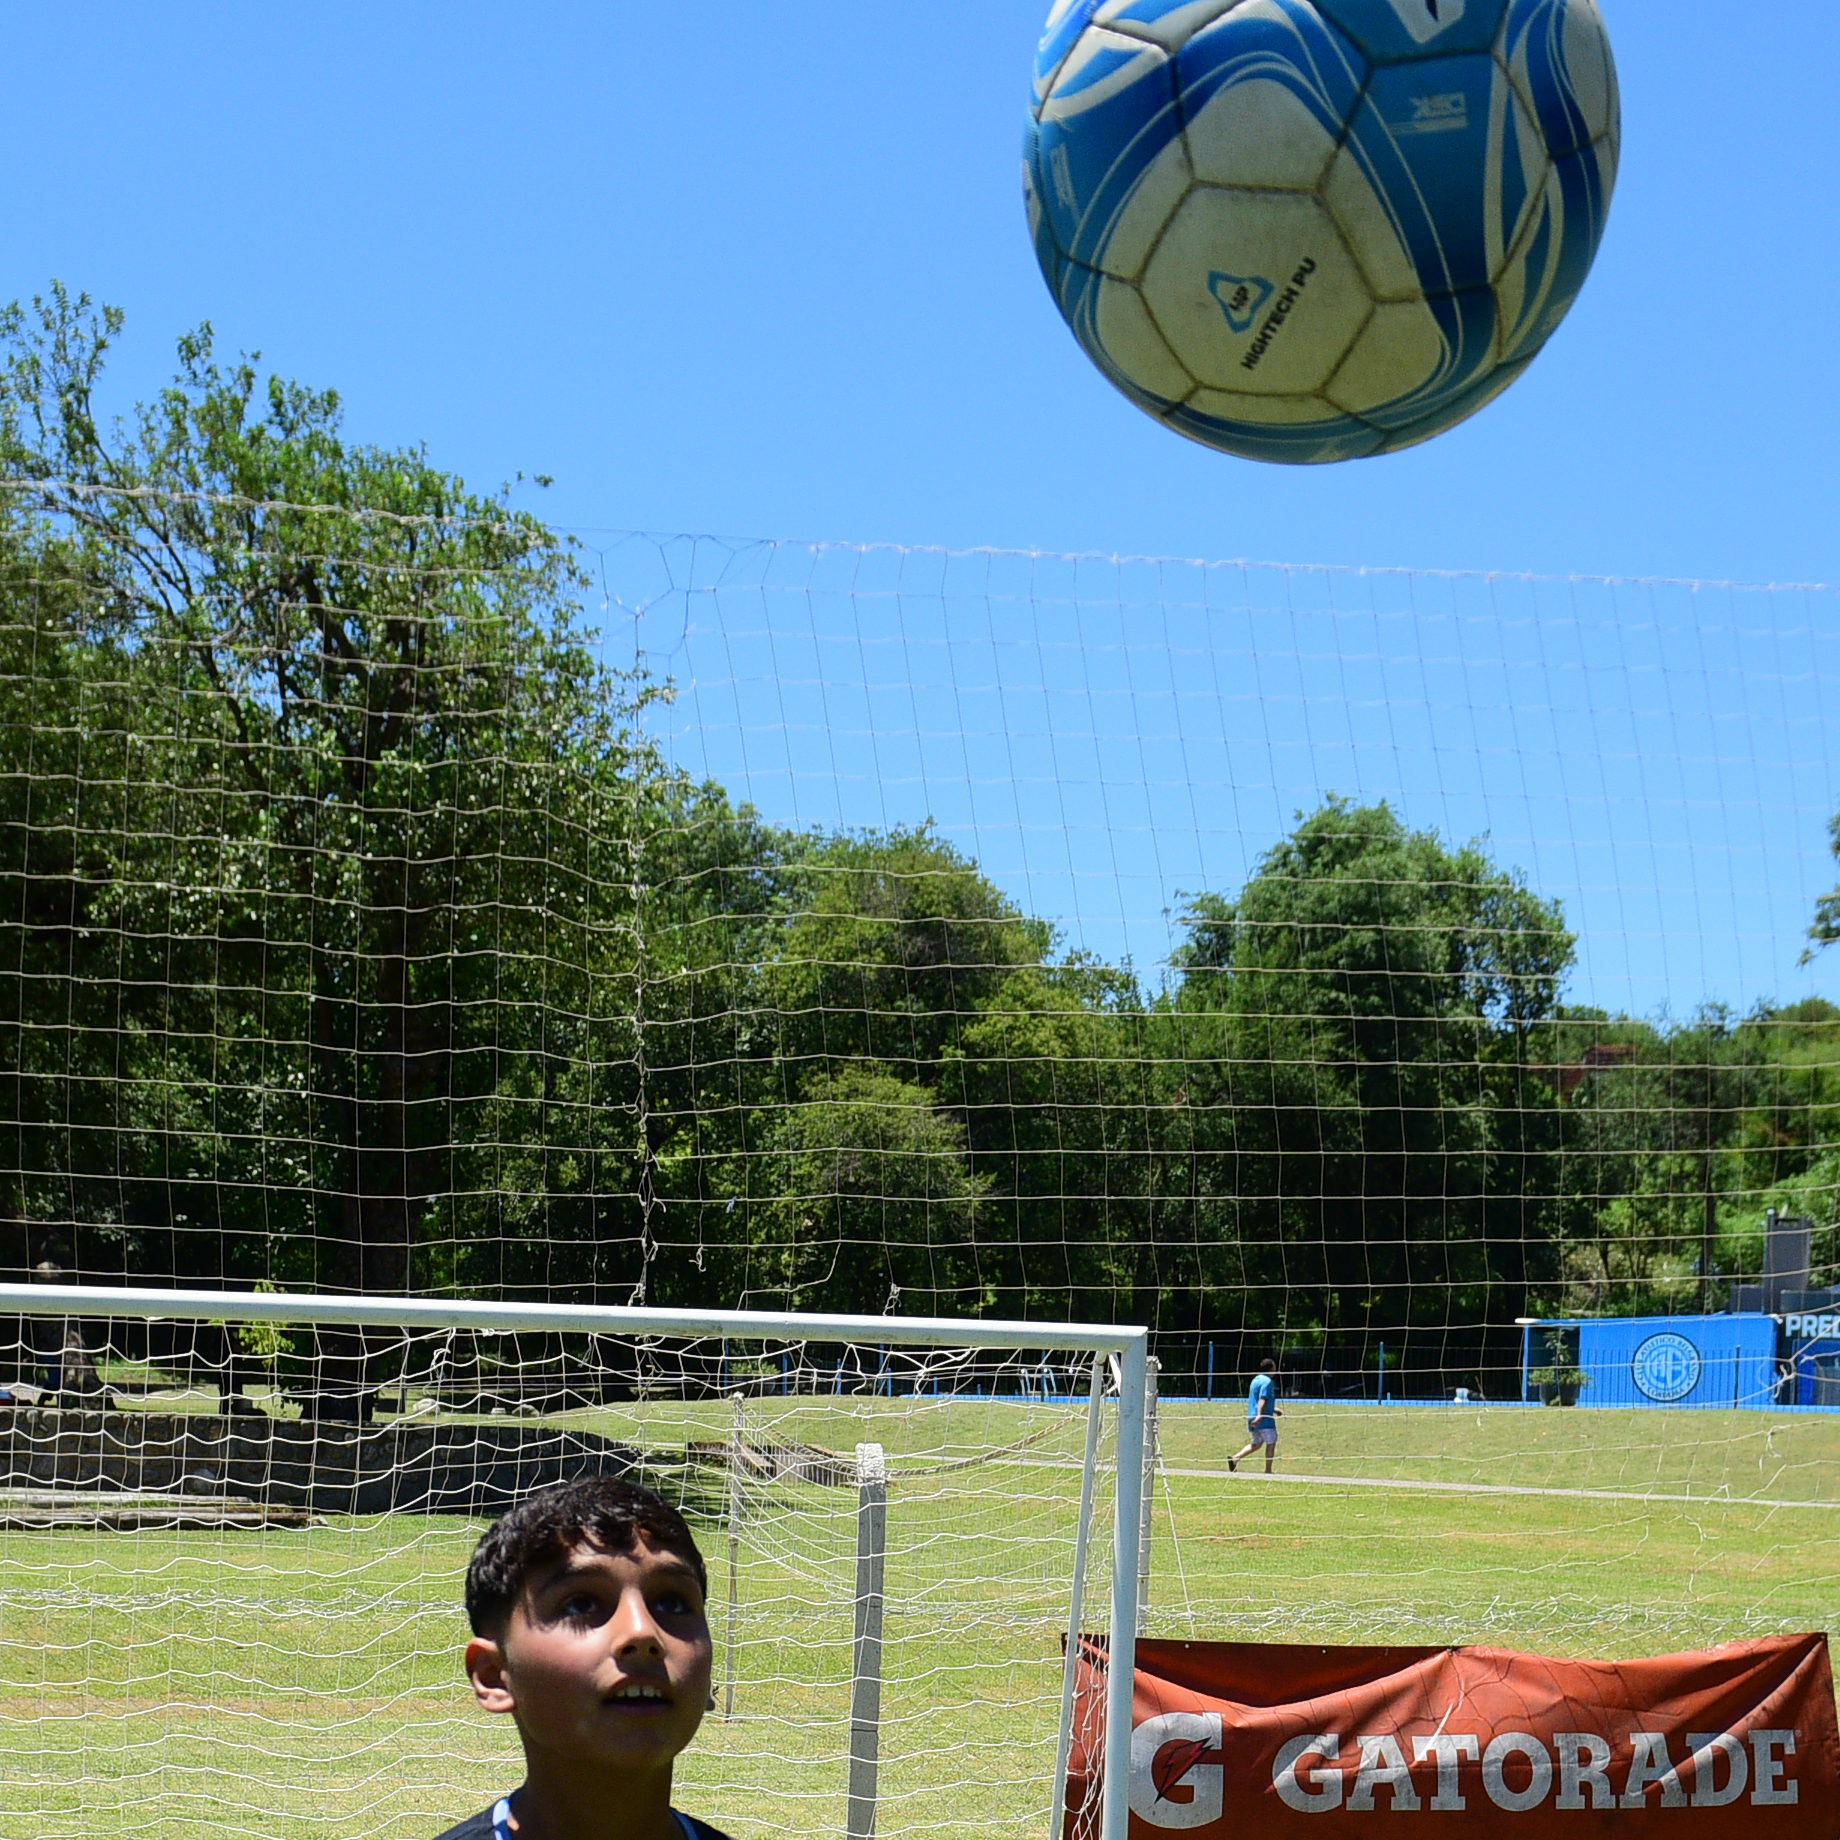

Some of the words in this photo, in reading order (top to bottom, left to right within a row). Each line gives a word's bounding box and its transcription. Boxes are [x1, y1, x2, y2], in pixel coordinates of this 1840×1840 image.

[1240, 286, 1300, 371] HIGHTECH
[1291, 256, 1317, 288] PU
[1128, 1711, 1224, 1829] G
[1272, 1729, 1799, 1813] GATORADE
